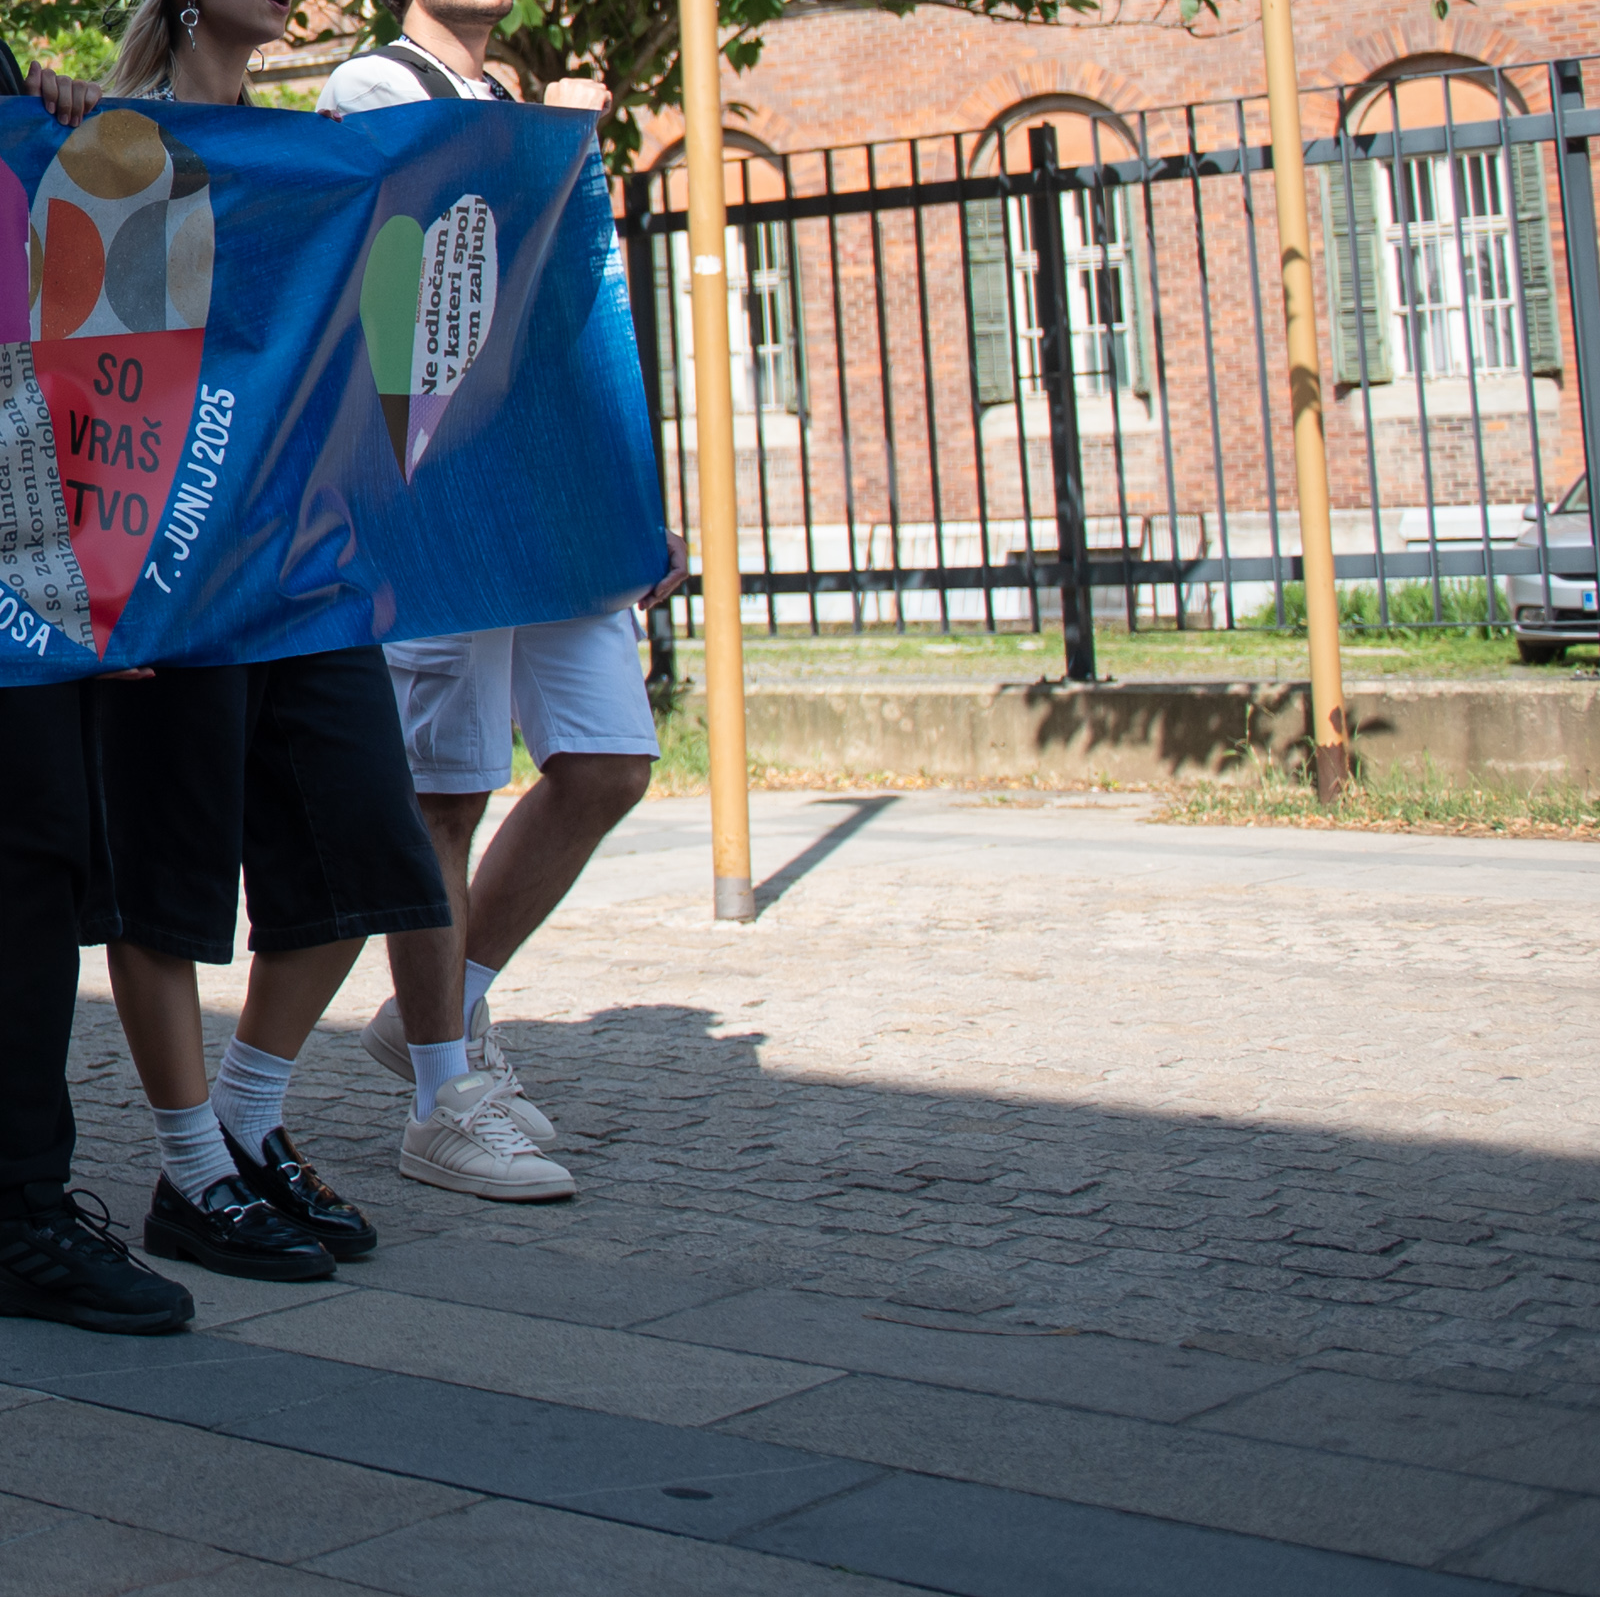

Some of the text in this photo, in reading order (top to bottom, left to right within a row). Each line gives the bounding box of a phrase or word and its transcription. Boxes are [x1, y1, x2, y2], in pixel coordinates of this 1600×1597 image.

[424, 228, 449, 355] odločam
[443, 205, 471, 384] v kateri spol
[93, 352, 143, 405] SO
[7, 396, 53, 577] zakoreninjena
[68, 416, 162, 473] VRAŠ
[144, 387, 235, 594] 7. JUNIJ 2025
[65, 479, 149, 536] TVO
[45, 583, 62, 611] so
